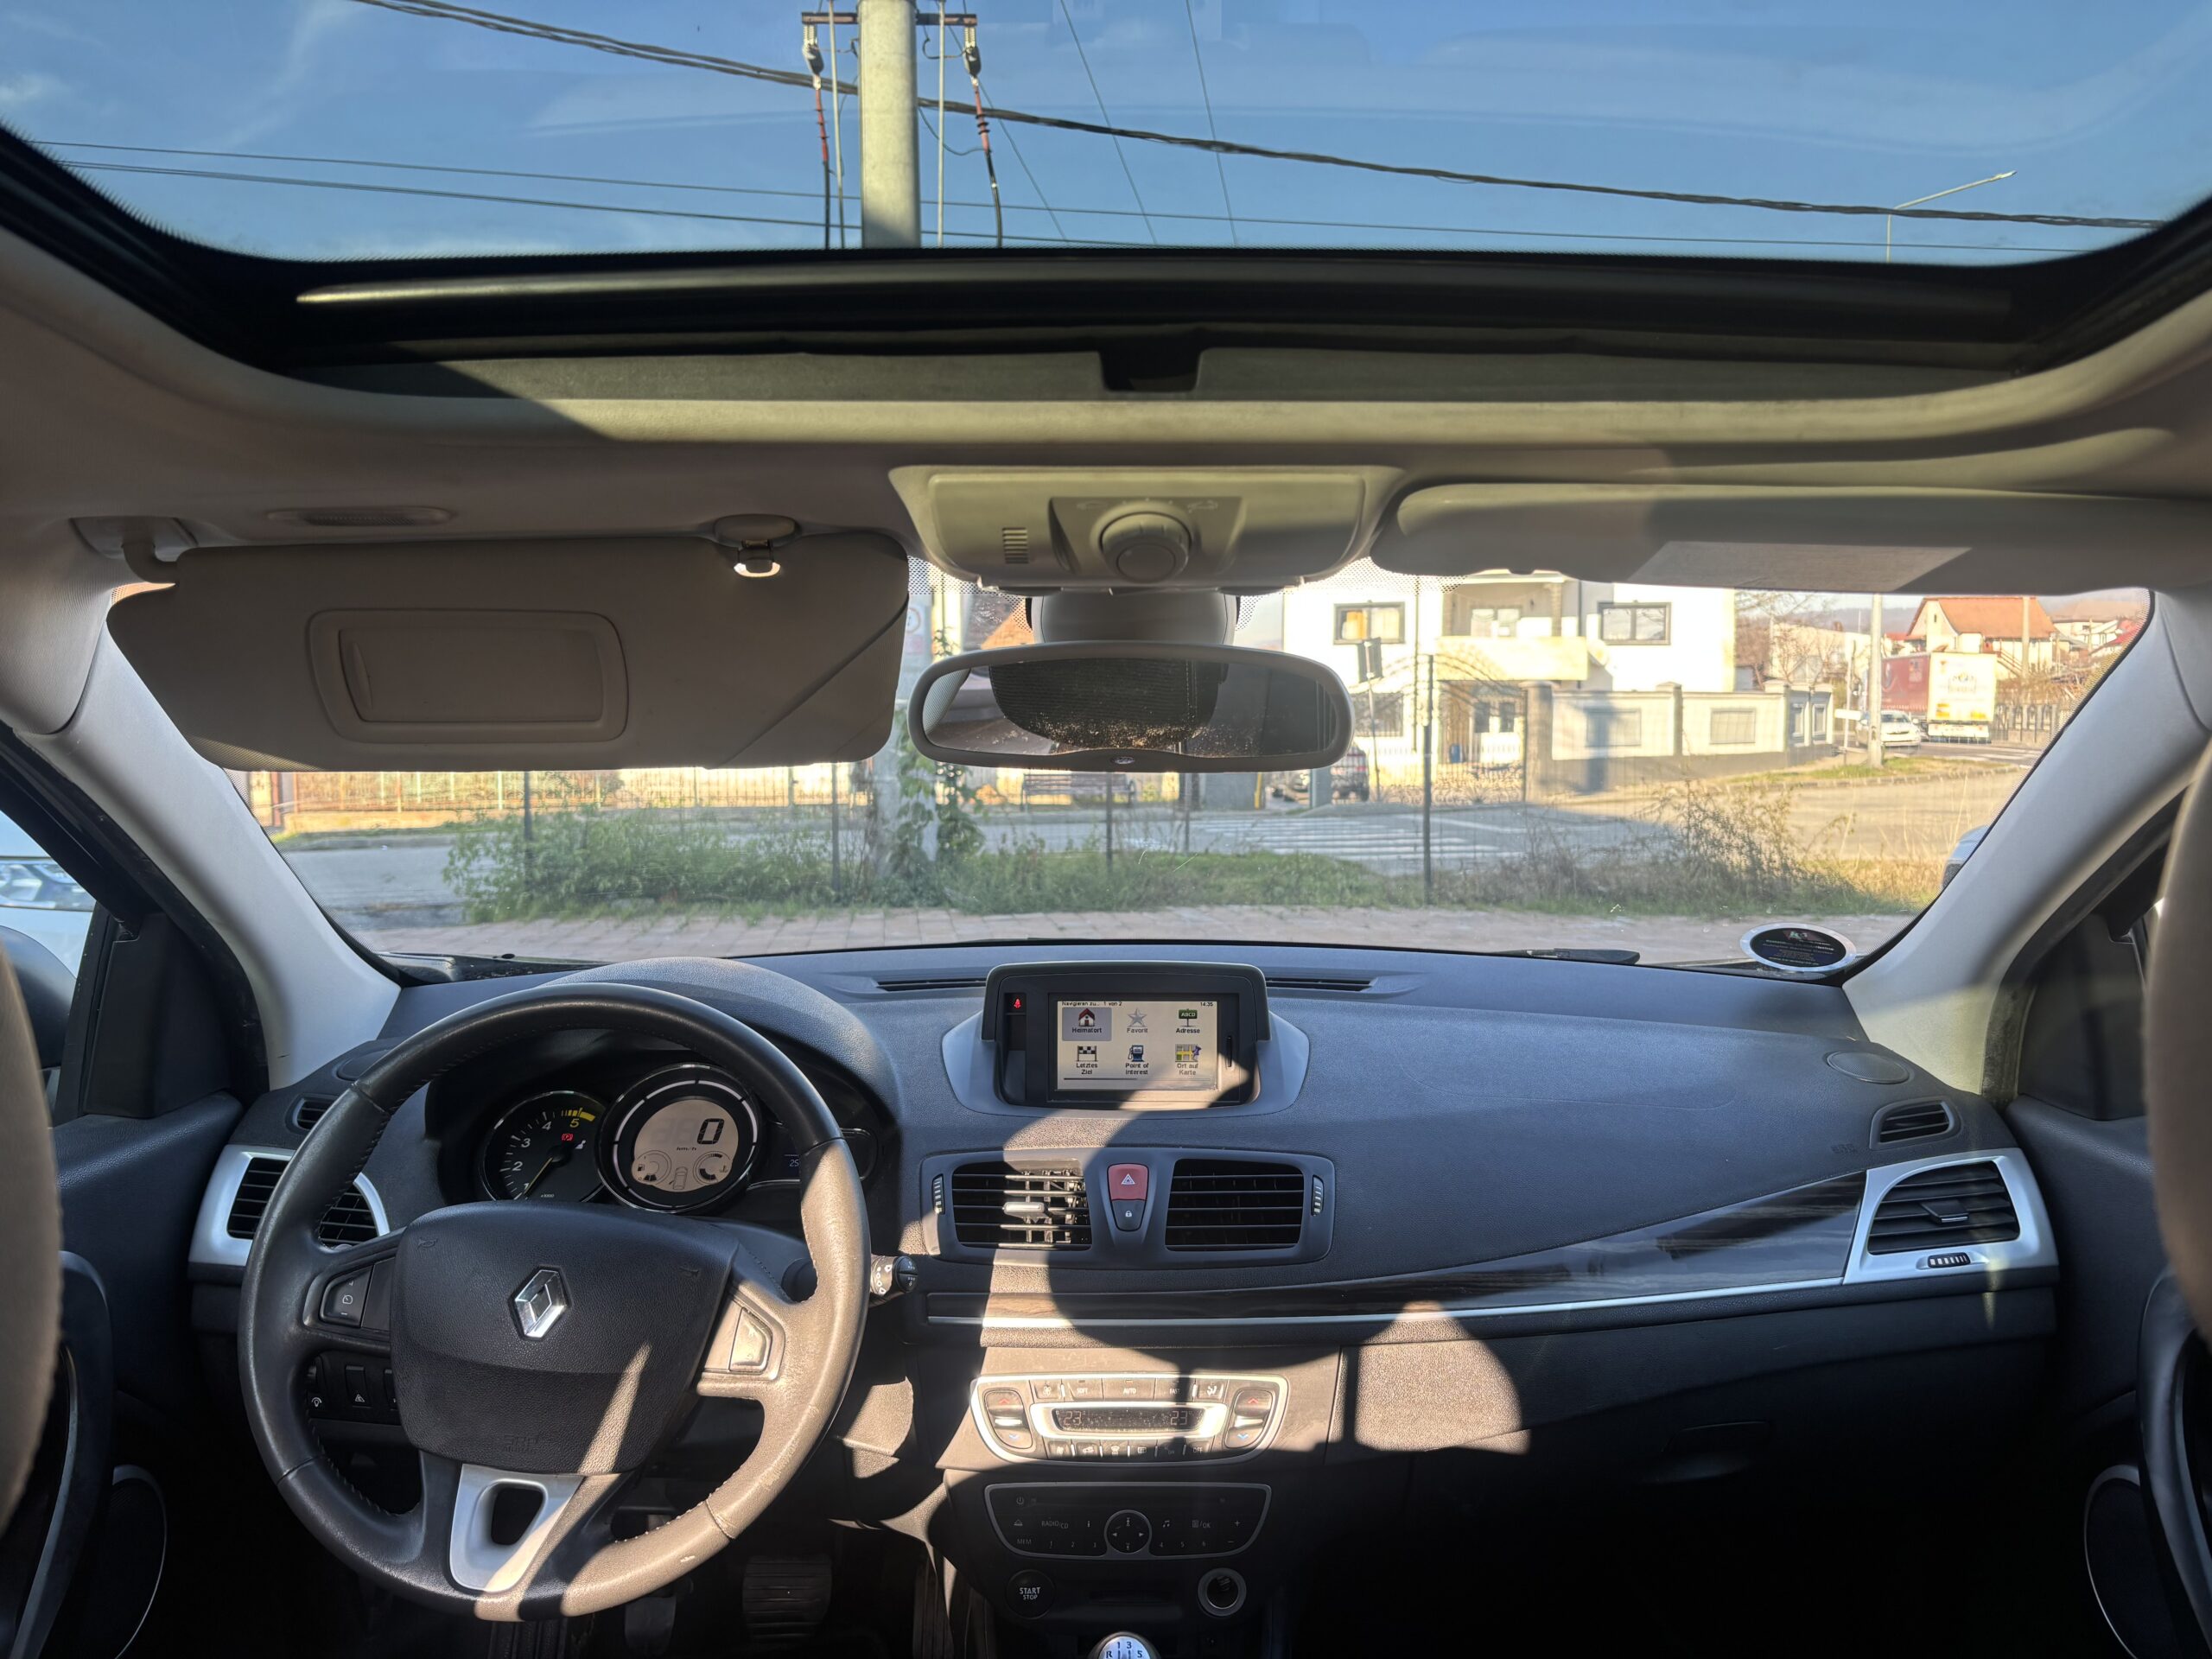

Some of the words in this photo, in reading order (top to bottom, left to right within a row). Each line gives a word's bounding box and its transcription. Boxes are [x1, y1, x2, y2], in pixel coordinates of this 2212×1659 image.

[542, 1121, 552, 1130] 4
[569, 1118, 580, 1128] 5
[696, 1118, 725, 1145] 0
[521, 1138, 531, 1147] 3
[512, 1160, 523, 1172] 2
[1019, 1586, 1041, 1595] START
[1126, 1641, 1132, 1649] 3
